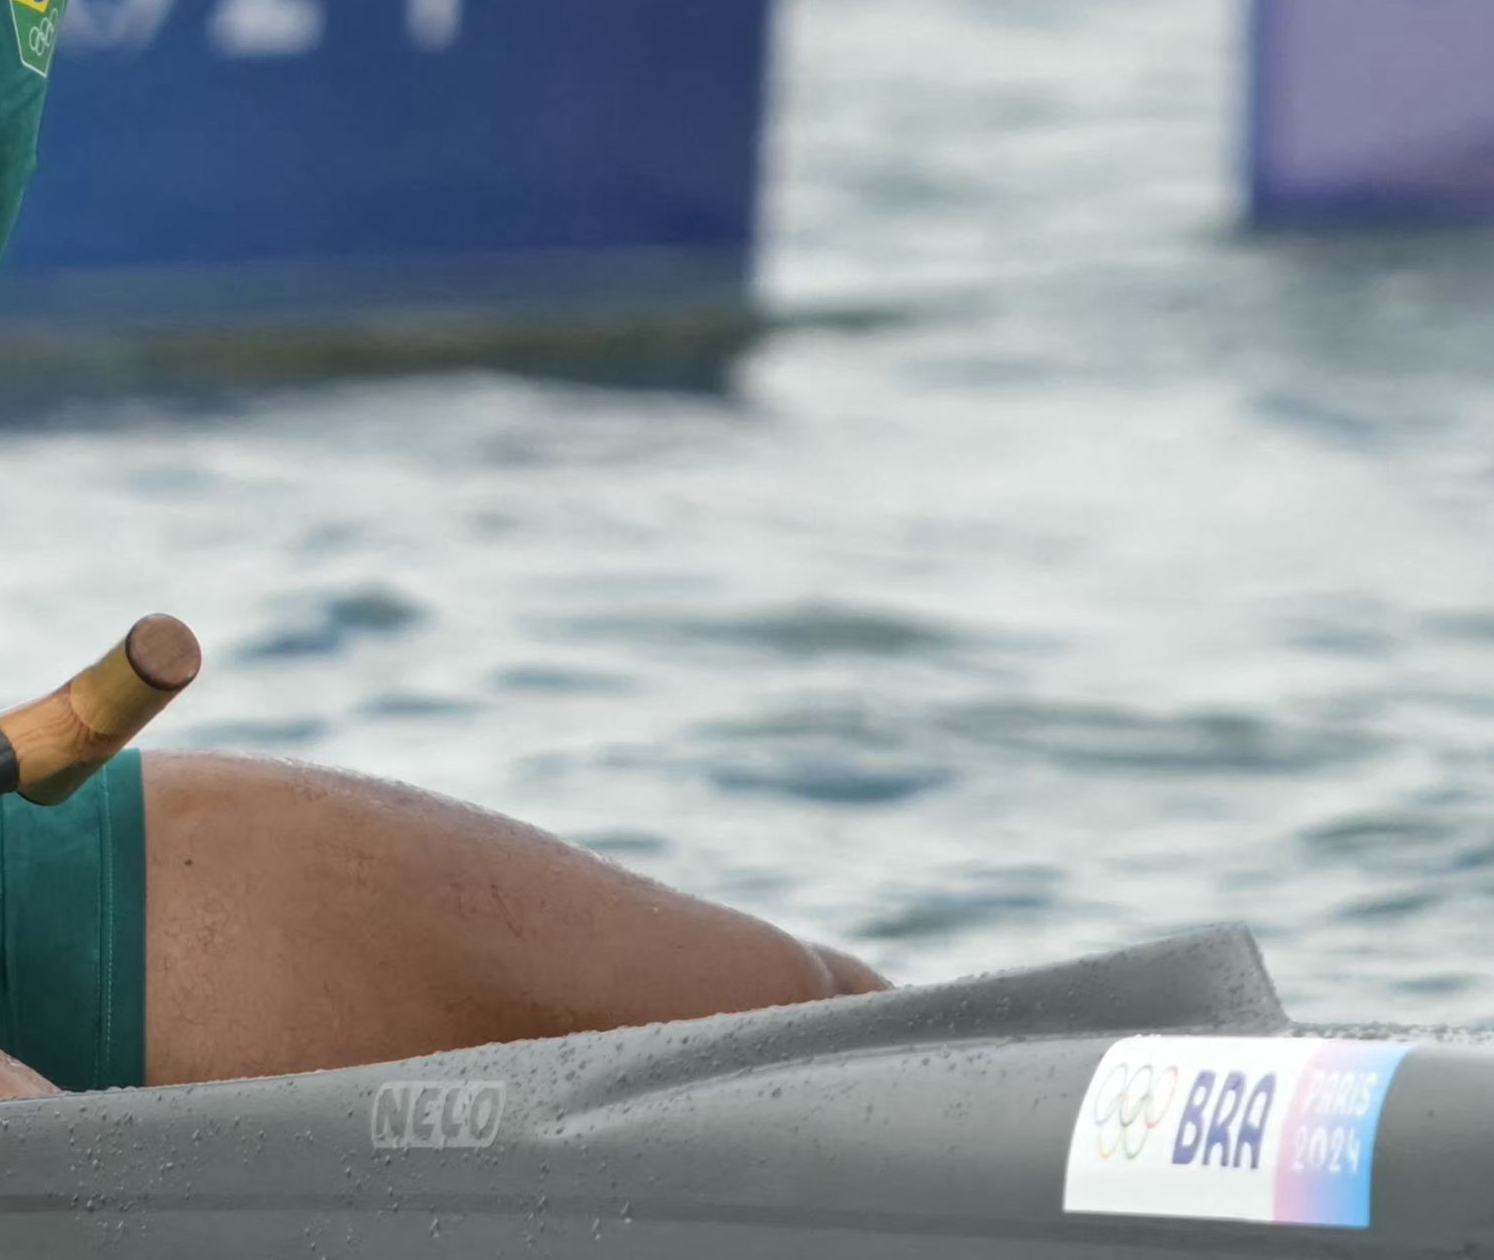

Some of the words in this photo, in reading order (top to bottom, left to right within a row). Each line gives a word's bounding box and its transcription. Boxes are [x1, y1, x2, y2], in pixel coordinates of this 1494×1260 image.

[373, 1085, 502, 1142] NELO
[1171, 1070, 1277, 1170] BRA
[1299, 1069, 1378, 1118] PARIS
[1291, 1125, 1362, 1173] 2024
